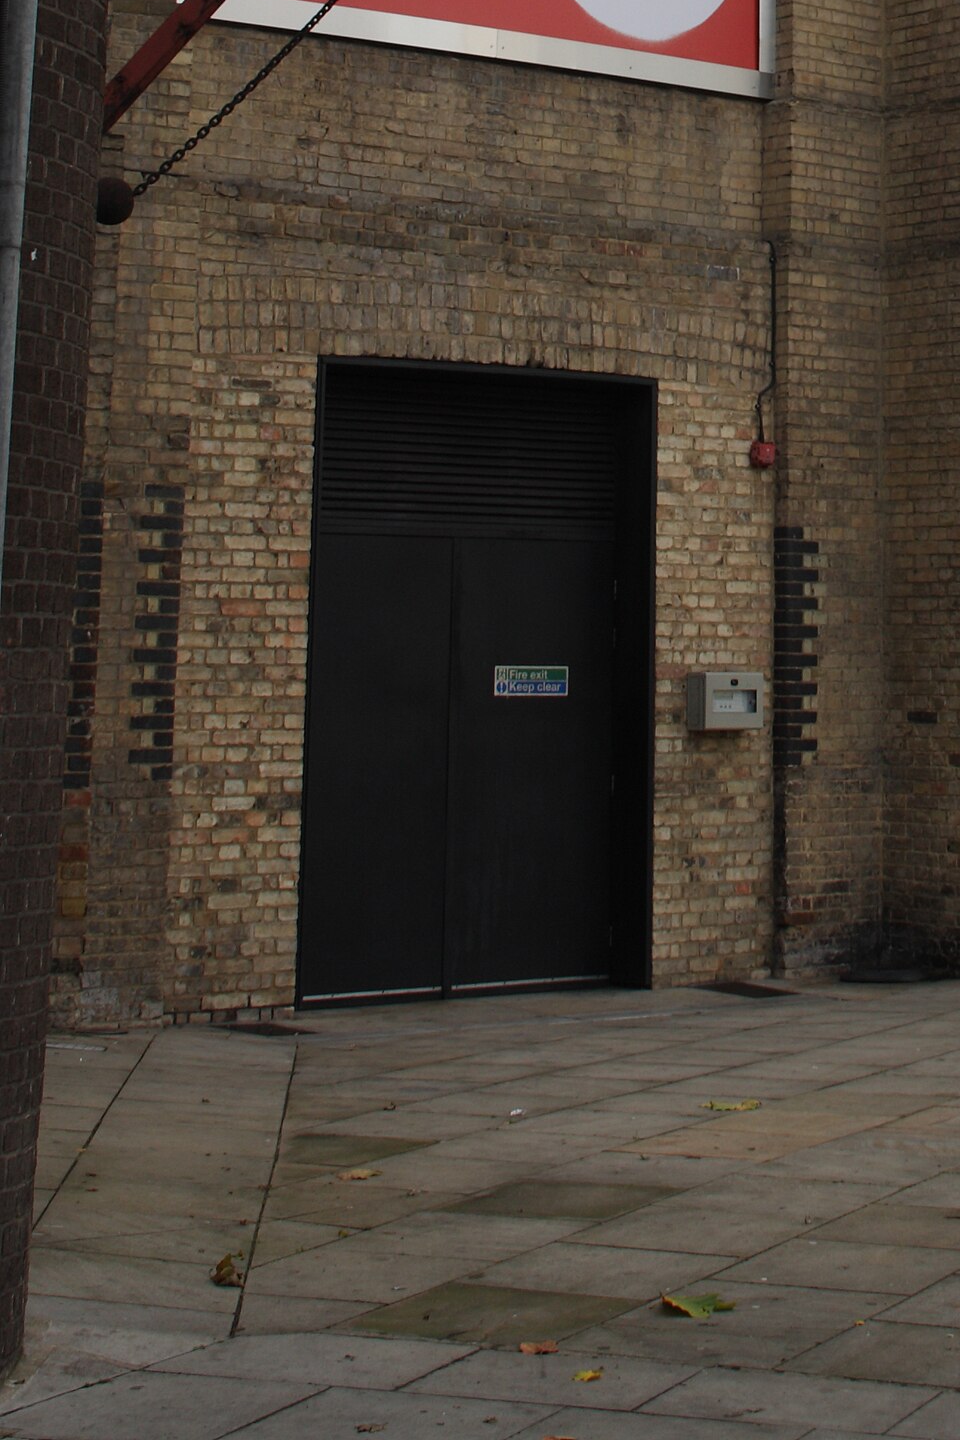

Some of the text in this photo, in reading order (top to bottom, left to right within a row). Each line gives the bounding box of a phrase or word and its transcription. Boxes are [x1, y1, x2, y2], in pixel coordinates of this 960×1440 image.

[509, 669, 548, 680] Fire exit
[509, 682, 561, 693] Keep clear
